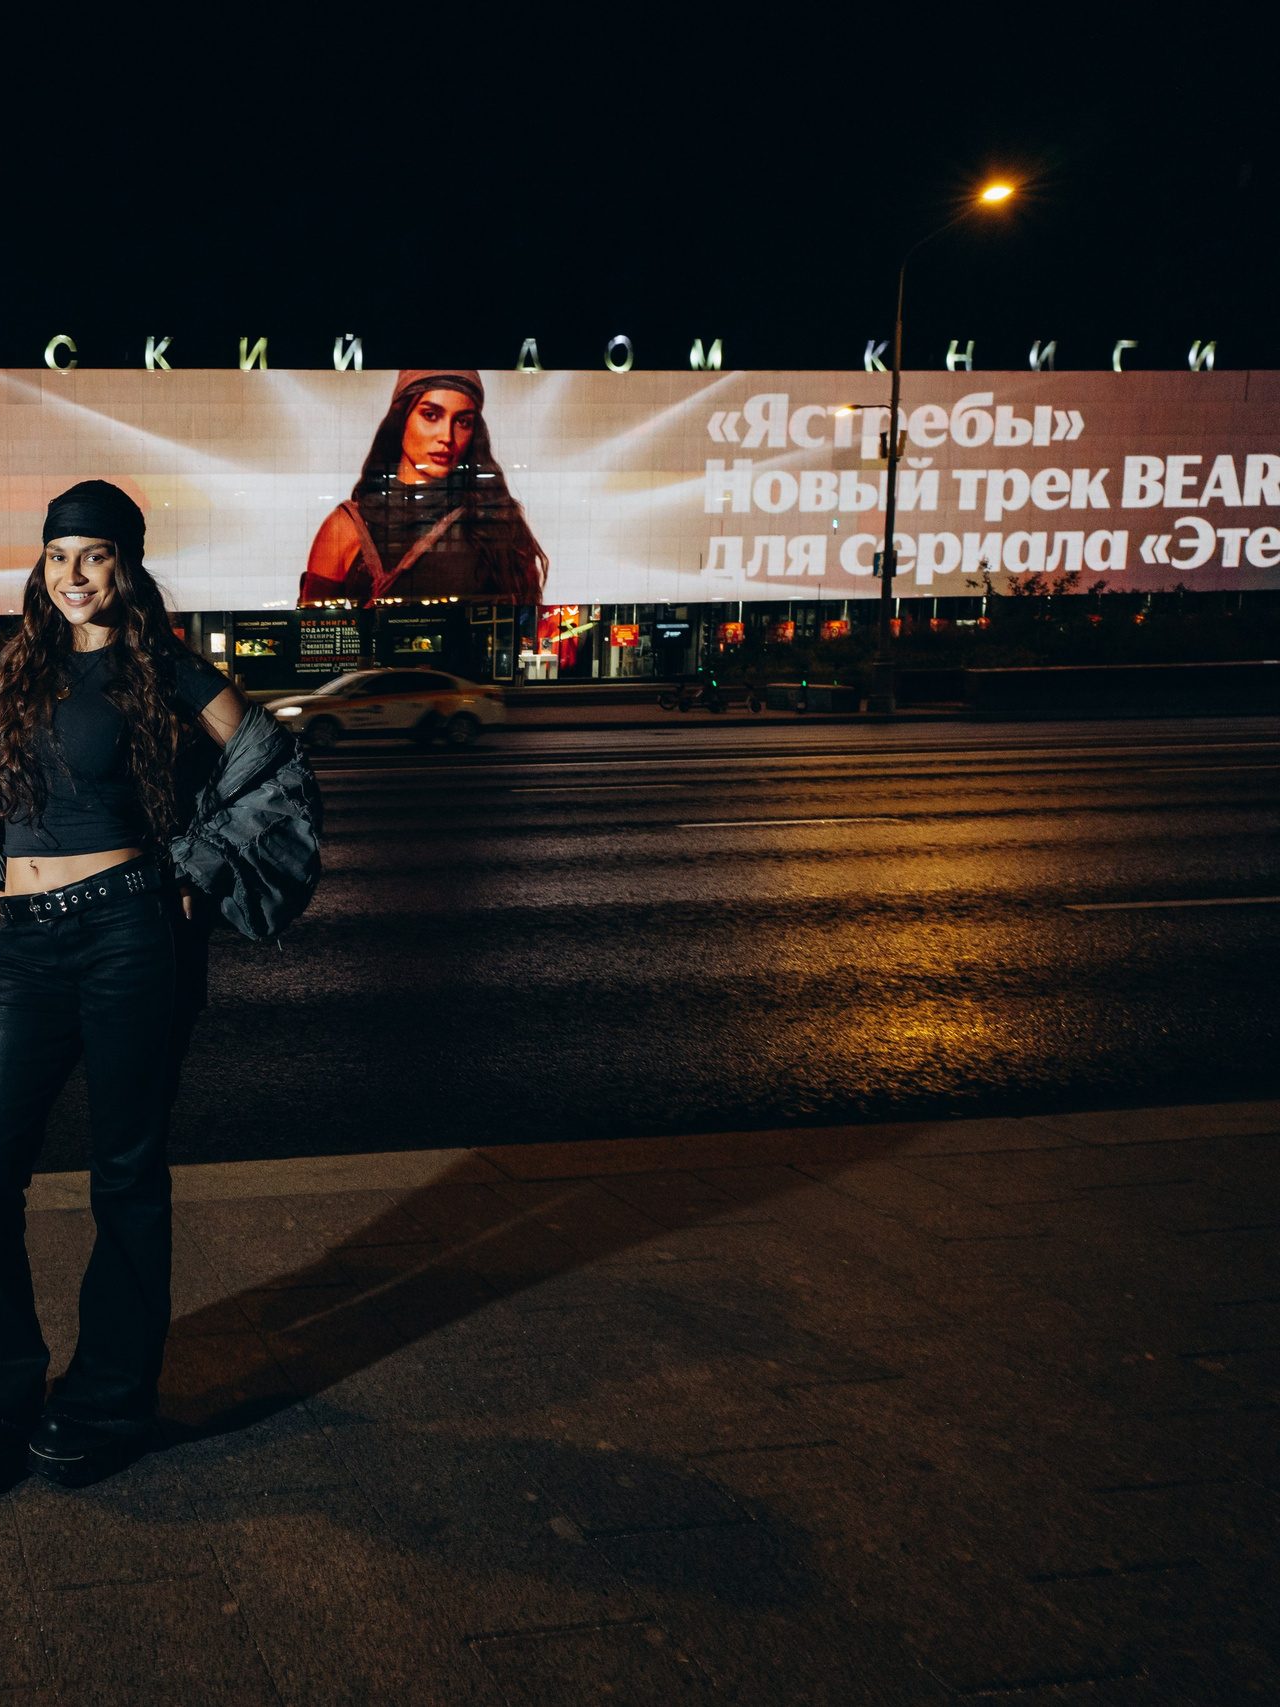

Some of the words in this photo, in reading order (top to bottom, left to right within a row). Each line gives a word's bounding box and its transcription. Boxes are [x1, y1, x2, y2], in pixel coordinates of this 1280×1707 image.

[516, 334, 724, 372] ДОМ
[863, 339, 1218, 372] КНИГИ
[707, 391, 1085, 459] «Ястребы»
[703, 456, 940, 514] Новый
[952, 467, 1110, 522] трек
[1122, 453, 1280, 508] BEAR
[701, 534, 828, 582] для
[839, 528, 1128, 586] сериала
[1140, 516, 1280, 570] «Эте
